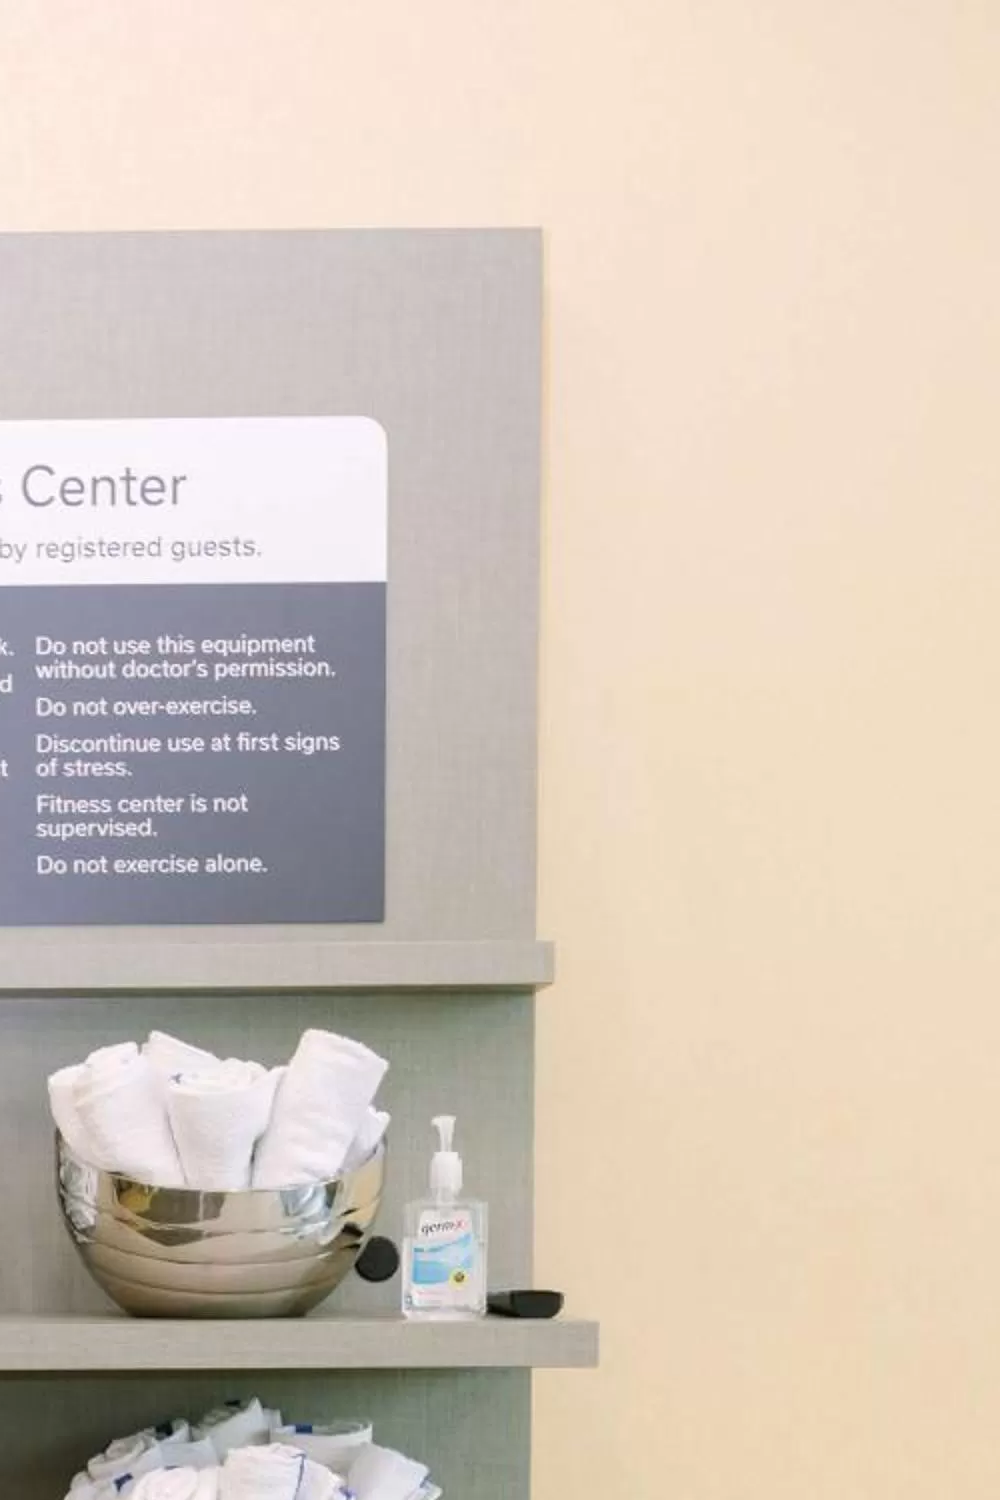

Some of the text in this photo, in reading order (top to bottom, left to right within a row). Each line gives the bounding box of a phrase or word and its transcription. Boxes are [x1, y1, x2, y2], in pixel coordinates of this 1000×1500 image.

[21, 464, 187, 508] Center
[36, 536, 162, 564] registered
[170, 536, 262, 563] guests.
[35, 633, 316, 657] Do not use this equipment
[35, 657, 336, 681] without doctor's permission.
[35, 695, 257, 717] Do not over-exercise.
[36, 731, 341, 755] Discontinue use at first signs
[35, 757, 133, 778] of stress.
[36, 793, 249, 815] Fitness center is not
[35, 817, 158, 841] supervised.
[36, 853, 268, 875] Do not exercise alone.
